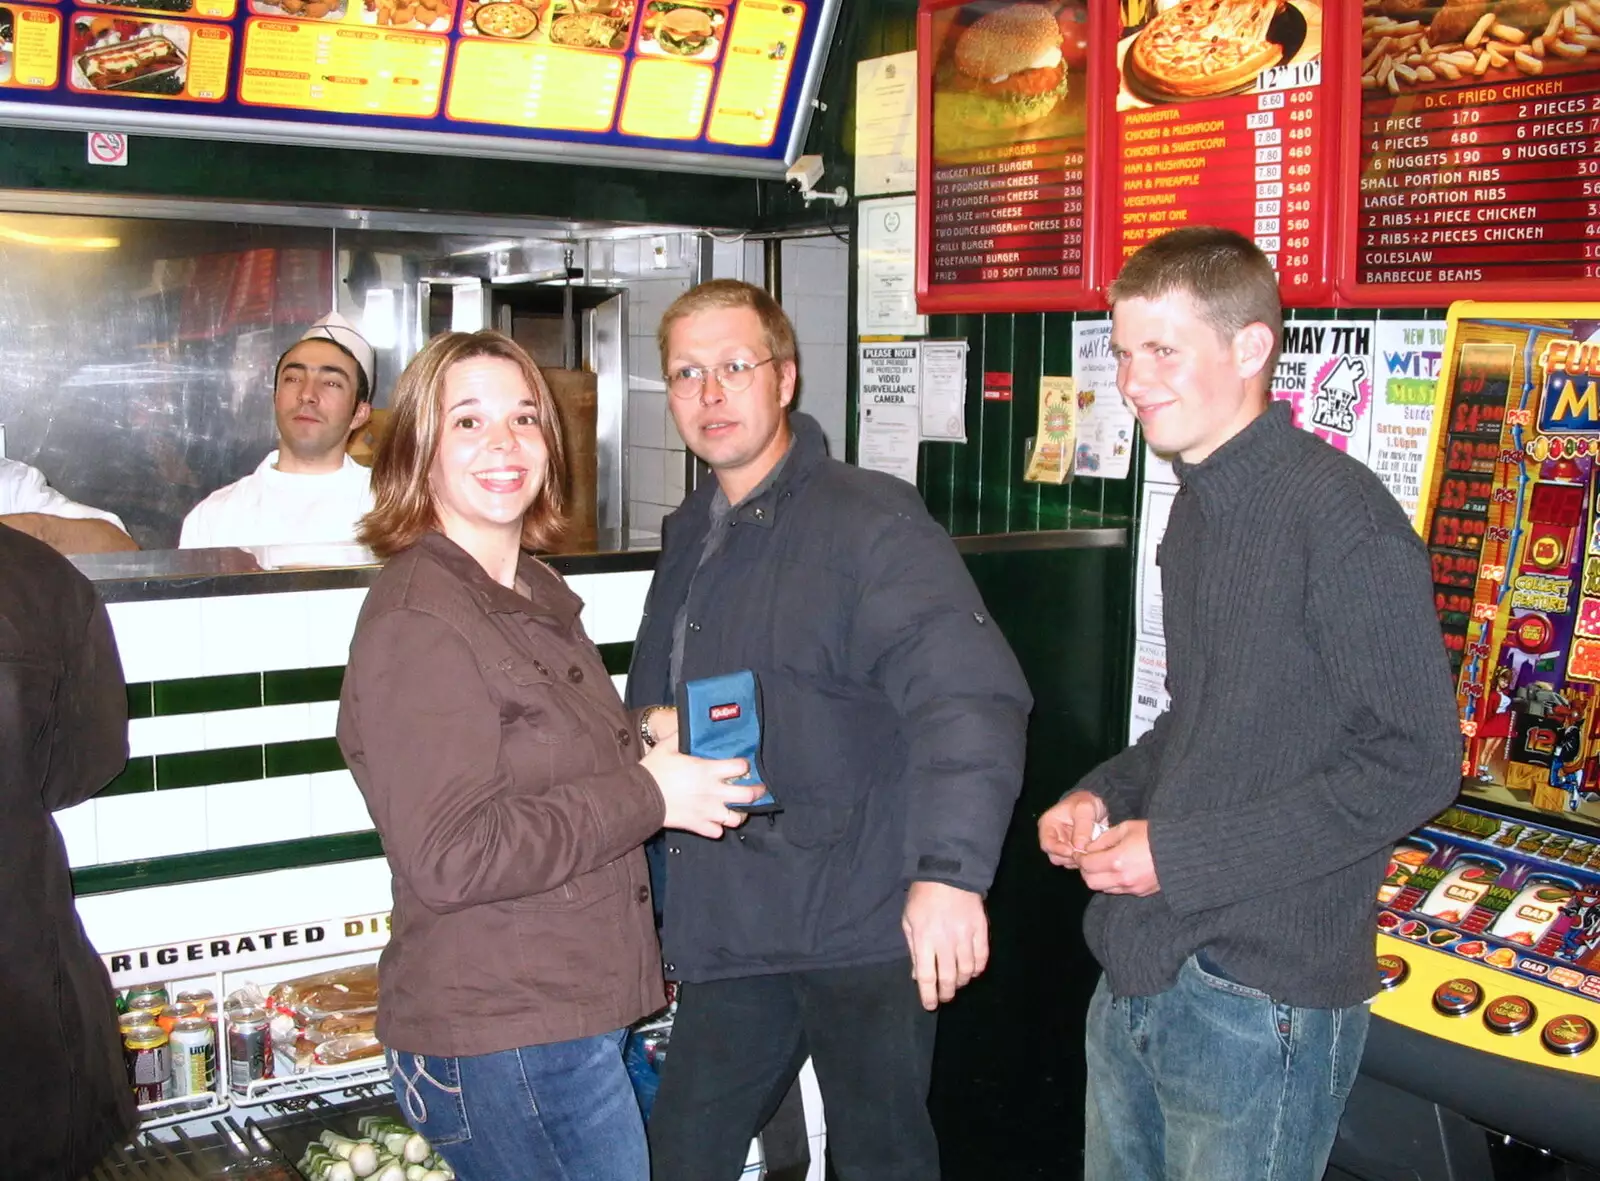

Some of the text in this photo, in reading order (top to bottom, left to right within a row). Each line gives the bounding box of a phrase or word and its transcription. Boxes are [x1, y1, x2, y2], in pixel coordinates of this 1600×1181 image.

[1425, 81, 1562, 108] D.C. FRIED CHICKEN
[1125, 92, 1313, 125] MARGHERITA 6.60 400
[1518, 99, 1586, 117] 2 PIECES
[1125, 109, 1312, 141] CHICKEN & MUSHROOM 7.80 480
[1374, 111, 1479, 132] 1 PIECE 170
[1517, 121, 1584, 138] 6 PIECES
[998, 144, 1037, 157] BURGERS
[1124, 128, 1312, 158] CHICKEN & SWEETCORN 7.80 480
[1372, 132, 1478, 151] 4 PIECES 480
[1502, 141, 1586, 159] 9 NUGGETS
[936, 155, 1082, 180] CHICKEN FILLET BURGER 240
[1124, 146, 1312, 174] HAM & MUSHROOM 7.80 460
[1374, 151, 1480, 170] 6 NUGGETS 190
[937, 185, 949, 194] 1/2
[952, 180, 989, 192] POUNDER
[1007, 175, 1039, 187] CHEESE
[1124, 179, 1143, 191] HAM
[1145, 178, 1152, 188] &
[1154, 174, 1199, 188] PINEAPPLE
[1259, 168, 1277, 178] 7.80
[1361, 178, 1399, 189] SMALL
[1405, 172, 1462, 186] PORTION
[1468, 169, 1500, 183] RIBS
[936, 200, 948, 208] 1/4
[952, 195, 989, 206] POUNDER
[1007, 190, 1038, 201] CHEESE
[1124, 182, 1310, 207] VEGETARIAN 8.60 540
[1365, 188, 1506, 207] LARGE PORTION RIBS
[936, 214, 953, 222] KING
[957, 212, 973, 221] SIZE
[991, 208, 1022, 218] CHEESE
[1123, 201, 1310, 224] SPICY HOT ONE 8.60 540
[1369, 216, 1376, 227] 2
[1434, 210, 1470, 222] PIECE
[1477, 207, 1536, 221] CHICKEN
[936, 228, 952, 237] TWO
[954, 226, 978, 235] OUNCE
[980, 223, 1012, 234] BURGER
[1029, 220, 1060, 230] CHEESE
[1064, 219, 1081, 228] 160
[1123, 229, 1144, 240] MEAT
[1287, 219, 1309, 230] 560
[1367, 235, 1374, 245] 2
[1432, 229, 1477, 242] PIECES
[1484, 227, 1543, 240] CHICKEN
[936, 243, 959, 252] CHILLI
[962, 240, 994, 250] BURGER
[1287, 237, 1309, 248] 460
[935, 250, 1080, 266] VEGETARIAN BURGER 220
[1287, 254, 1309, 266] 260
[1365, 252, 1433, 264] COLESLAW
[936, 270, 998, 280] FRIES 100
[1003, 269, 1023, 278] SOFT
[1027, 267, 1059, 276] DRINKS
[1294, 273, 1308, 284] 60
[1367, 269, 1482, 283] BARBECUE BEANS
[1283, 327, 1370, 354] MAY 7TH
[1403, 328, 1424, 345] NEW
[866, 349, 913, 357] PLEASE NOTE
[1278, 362, 1306, 375] THE
[878, 375, 900, 383] VIDEO
[864, 385, 916, 393] SURVEILLANCE
[874, 395, 904, 403] CAMERA
[1515, 576, 1572, 596] COLLECT
[1512, 591, 1568, 612] FEATURE
[1138, 694, 1158, 708] RAFFLE
[1418, 865, 1445, 880] WIN
[1447, 885, 1477, 899] BAR
[1489, 884, 1517, 899] WIN
[1520, 905, 1552, 920] BAR
[111, 926, 326, 973] RIGERATED
[1521, 960, 1545, 974] BAR
[1448, 981, 1472, 993] HOLD
